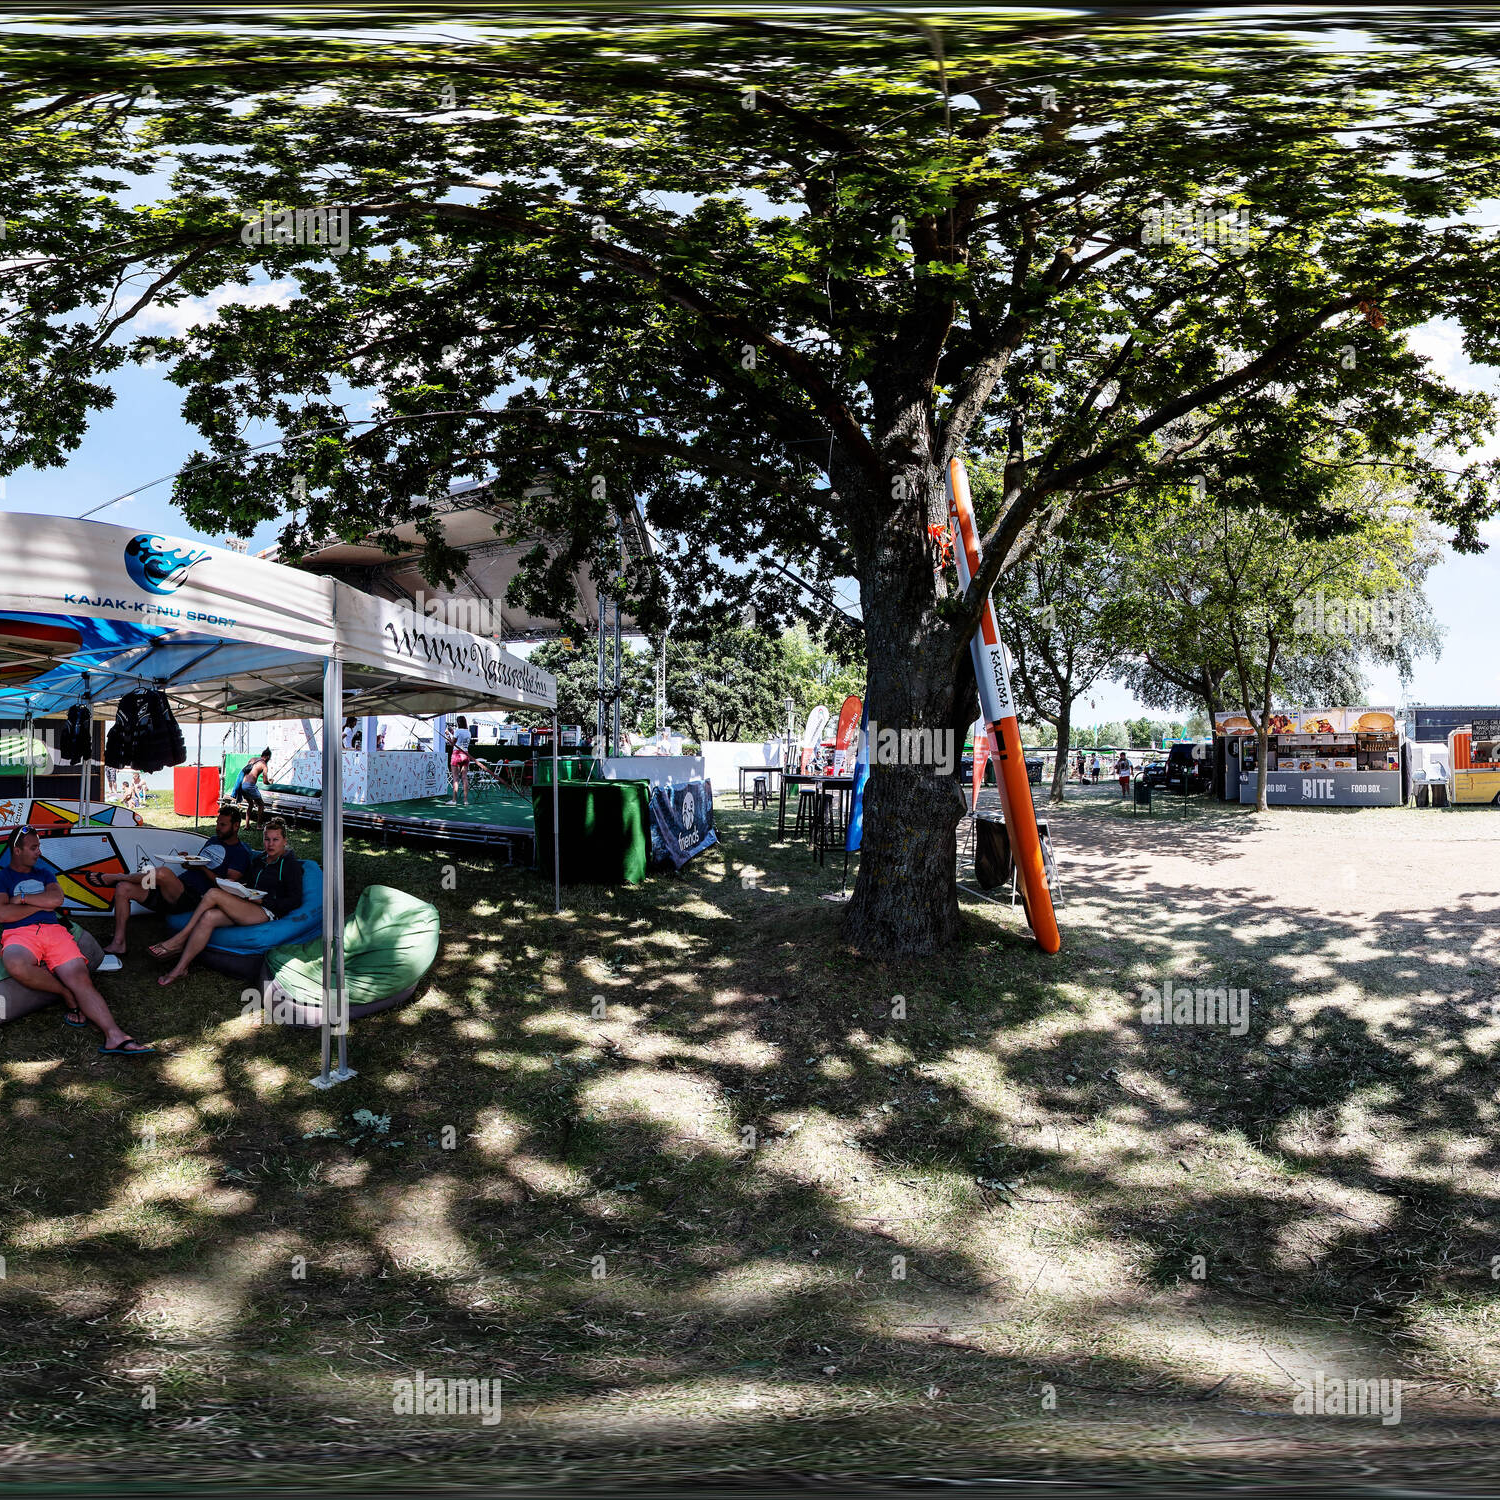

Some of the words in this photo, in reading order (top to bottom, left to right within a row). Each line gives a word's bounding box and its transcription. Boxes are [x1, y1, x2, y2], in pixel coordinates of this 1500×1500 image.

[64, 593, 181, 619] KAJAK-KENU
[186, 611, 237, 629] SPORT
[990, 648, 1009, 709] KAZUMA
[1275, 784, 1287, 792] BOX
[1302, 778, 1334, 799] BITE
[1351, 784, 1367, 793] FOOD
[1367, 784, 1380, 793] BOX
[678, 824, 699, 852] friends
